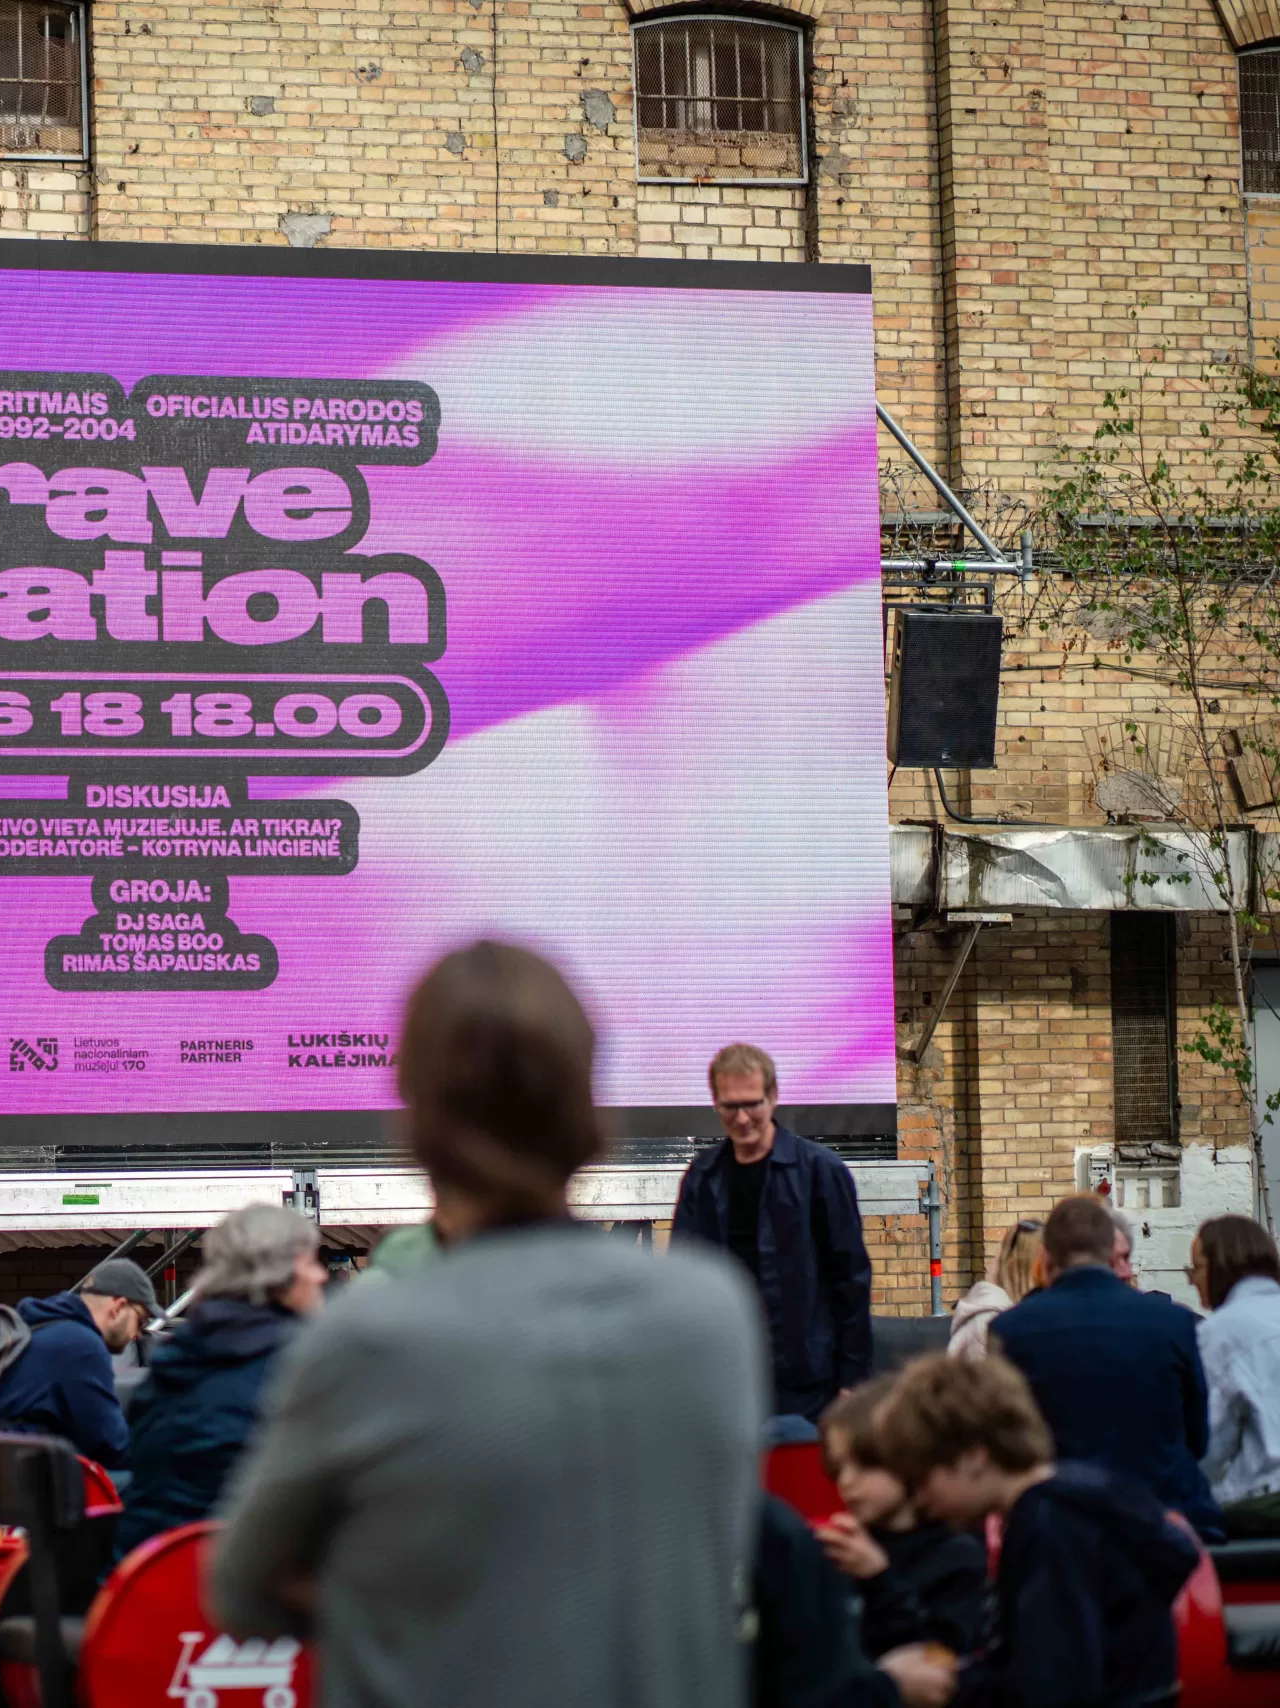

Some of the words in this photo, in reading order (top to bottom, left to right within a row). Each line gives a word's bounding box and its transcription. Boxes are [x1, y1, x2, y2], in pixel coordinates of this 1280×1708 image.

[146, 394, 289, 419] OFICIALUS
[293, 398, 424, 422] PARODOS
[245, 422, 421, 447] ATIDARYMAS
[50, 692, 144, 738] 18
[160, 692, 403, 738] 18.00
[86, 784, 231, 808] DISKUSIJA
[40, 818, 101, 836] VIETA
[103, 818, 227, 837] MUZIEJUJE.
[229, 818, 260, 836] AR
[262, 818, 342, 837] TIKRAI?
[141, 839, 242, 857] KOTRYNA
[245, 836, 341, 857] LINGIENĖ
[109, 879, 211, 903] GROJA:
[116, 913, 144, 931] DJ
[147, 913, 206, 931] SAGA
[99, 933, 175, 951] TOMAS
[178, 933, 224, 951] BOO
[63, 953, 130, 972] RIMAS
[133, 949, 261, 972] ŠAPAUSKAS
[74, 1037, 119, 1048] Lietuvos
[180, 1040, 254, 1050] PARTNERIS
[287, 1030, 389, 1050] LUKIŠKIŲ
[74, 1048, 149, 1059] nacionaliniam
[180, 1053, 242, 1063] PARTNER
[74, 1060, 119, 1073] muziejui
[122, 1060, 146, 1071] 170
